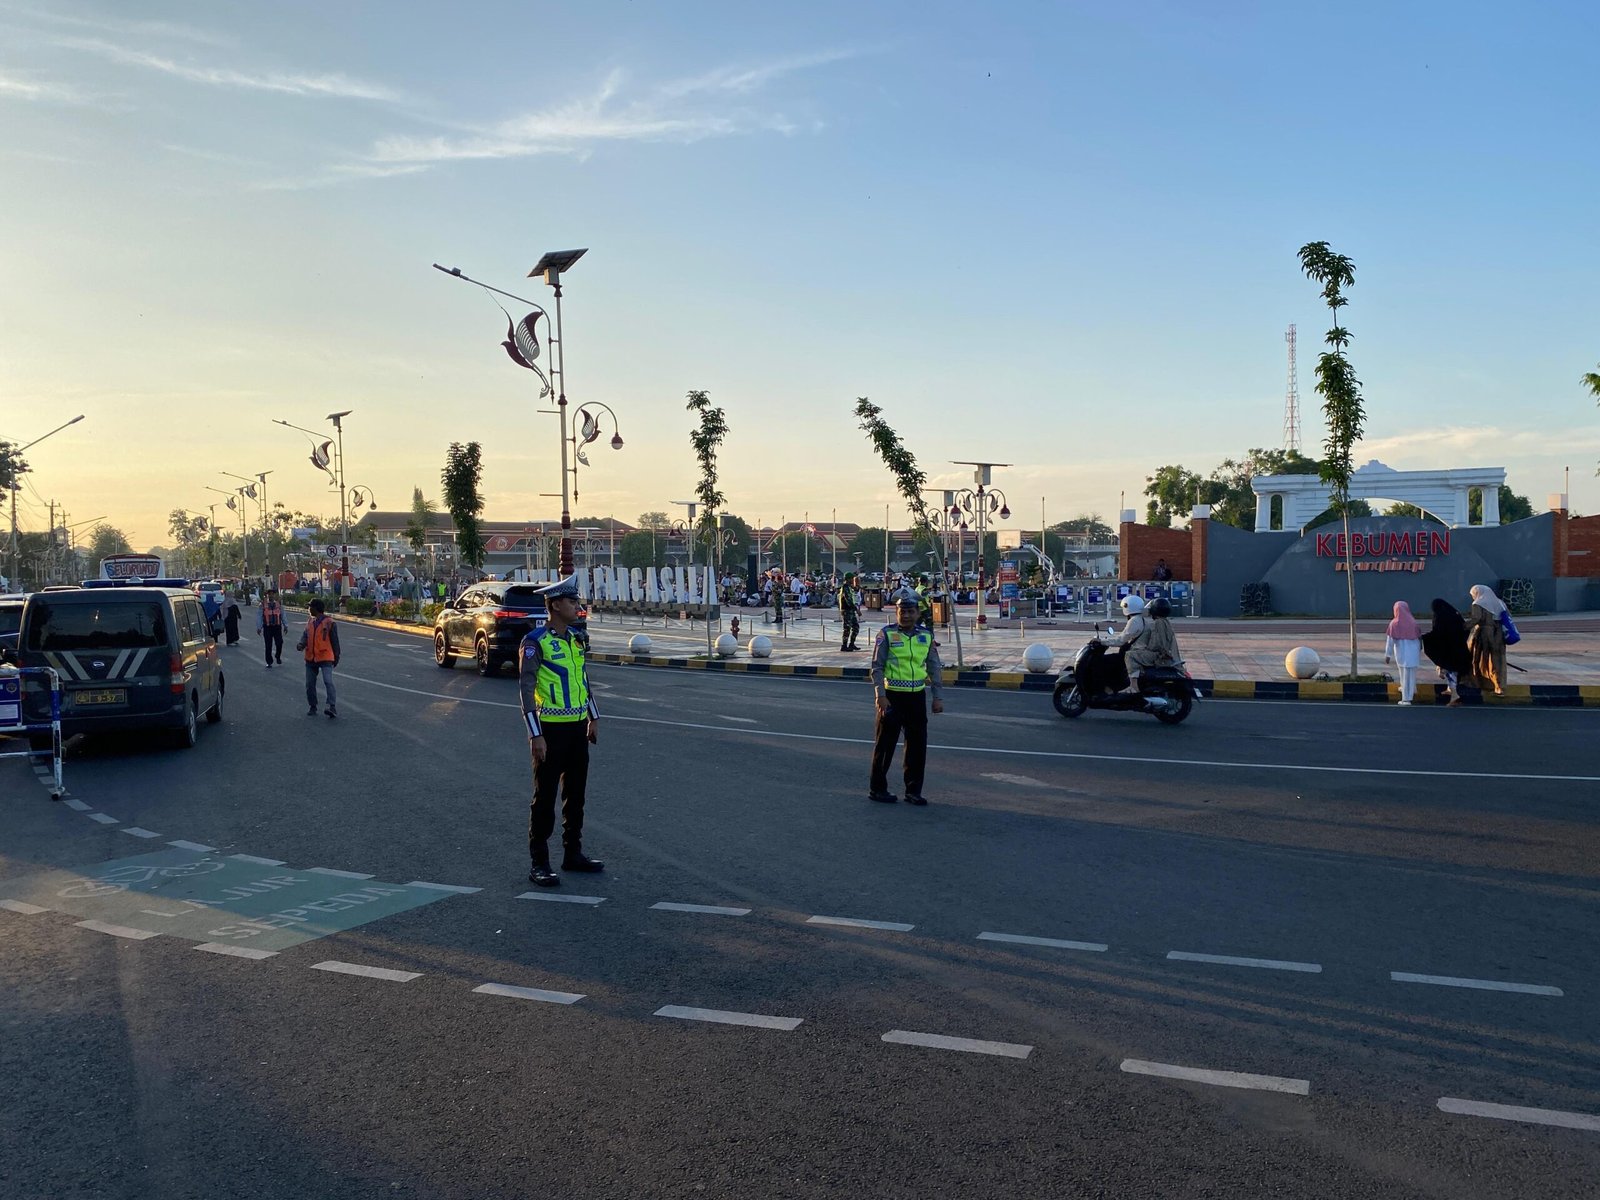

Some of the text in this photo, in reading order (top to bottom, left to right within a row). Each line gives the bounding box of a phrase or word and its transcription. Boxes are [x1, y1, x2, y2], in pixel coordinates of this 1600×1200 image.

[1316, 530, 1451, 556] KEBUMEN
[139, 876, 308, 917] LAJUR
[207, 886, 408, 940] SEPEDA
